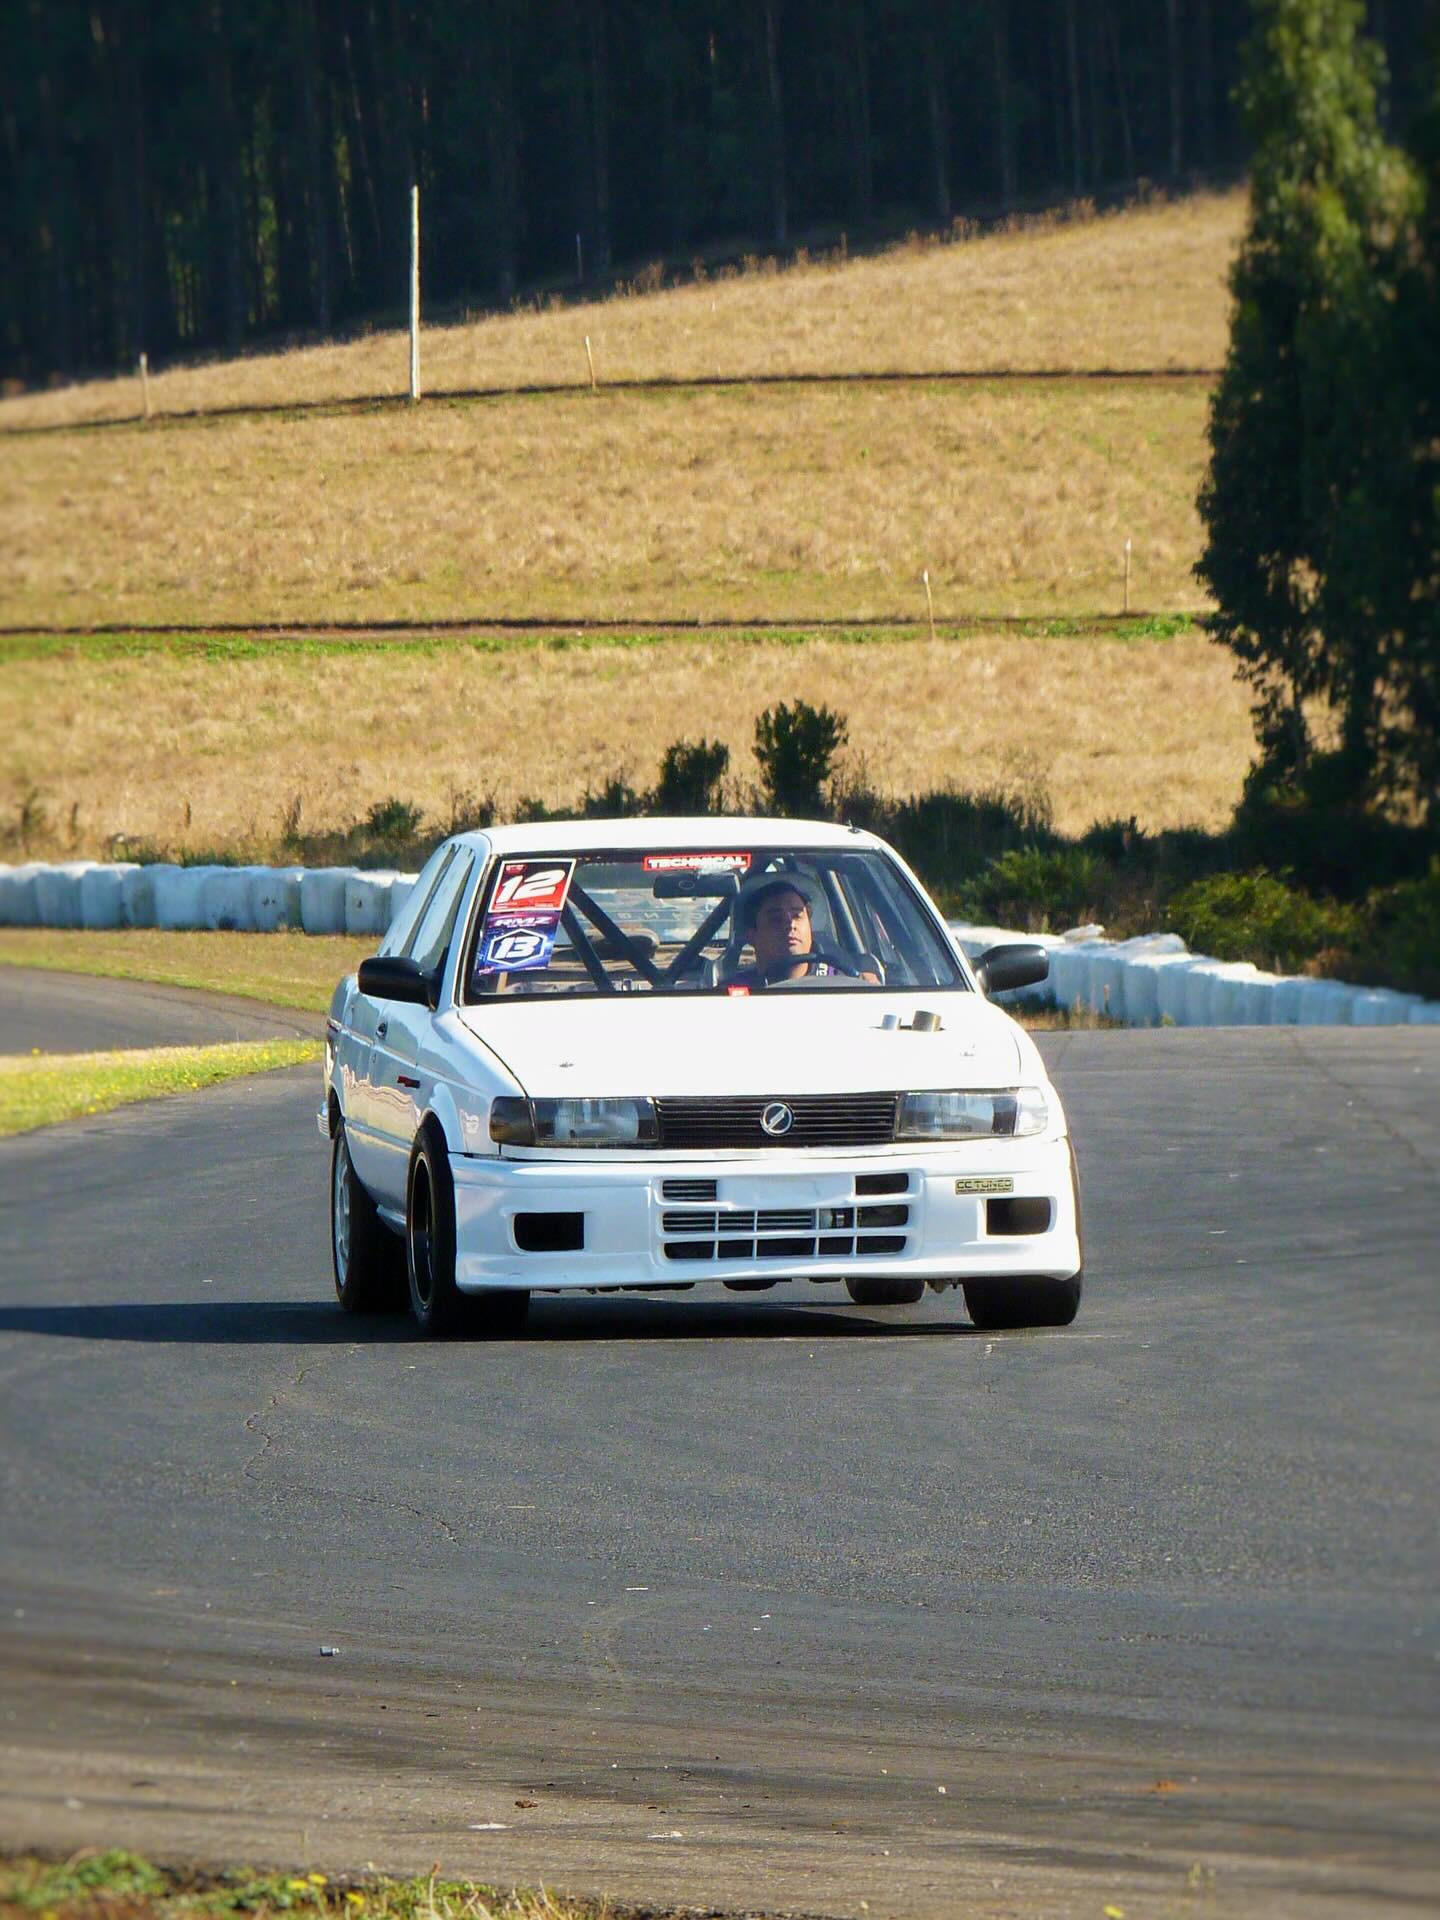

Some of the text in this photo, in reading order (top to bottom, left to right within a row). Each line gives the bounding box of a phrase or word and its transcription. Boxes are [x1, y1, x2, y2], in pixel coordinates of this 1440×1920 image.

[648, 856, 747, 869] TECHNICAL
[496, 869, 566, 904] 12
[493, 936, 541, 959] 13
